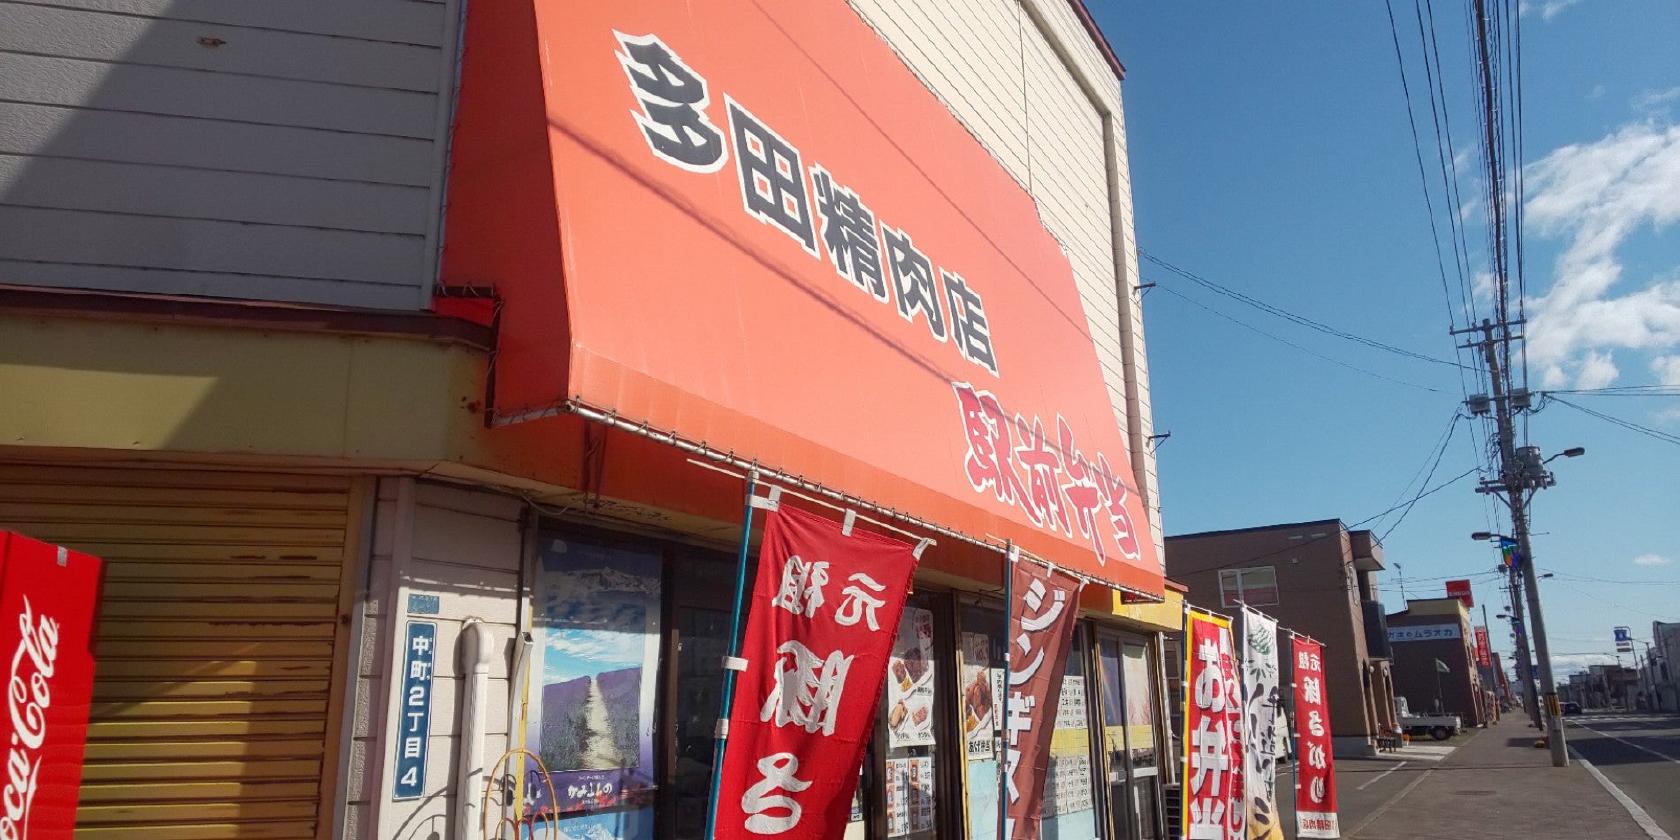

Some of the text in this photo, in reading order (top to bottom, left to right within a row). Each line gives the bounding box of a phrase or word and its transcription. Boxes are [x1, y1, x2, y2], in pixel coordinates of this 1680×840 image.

[612, 29, 999, 378] 多田精肉店
[952, 381, 1140, 566] 駅前弁当
[400, 636, 430, 787] 中町2丁目4
[1006, 578, 1066, 840] ジンギス
